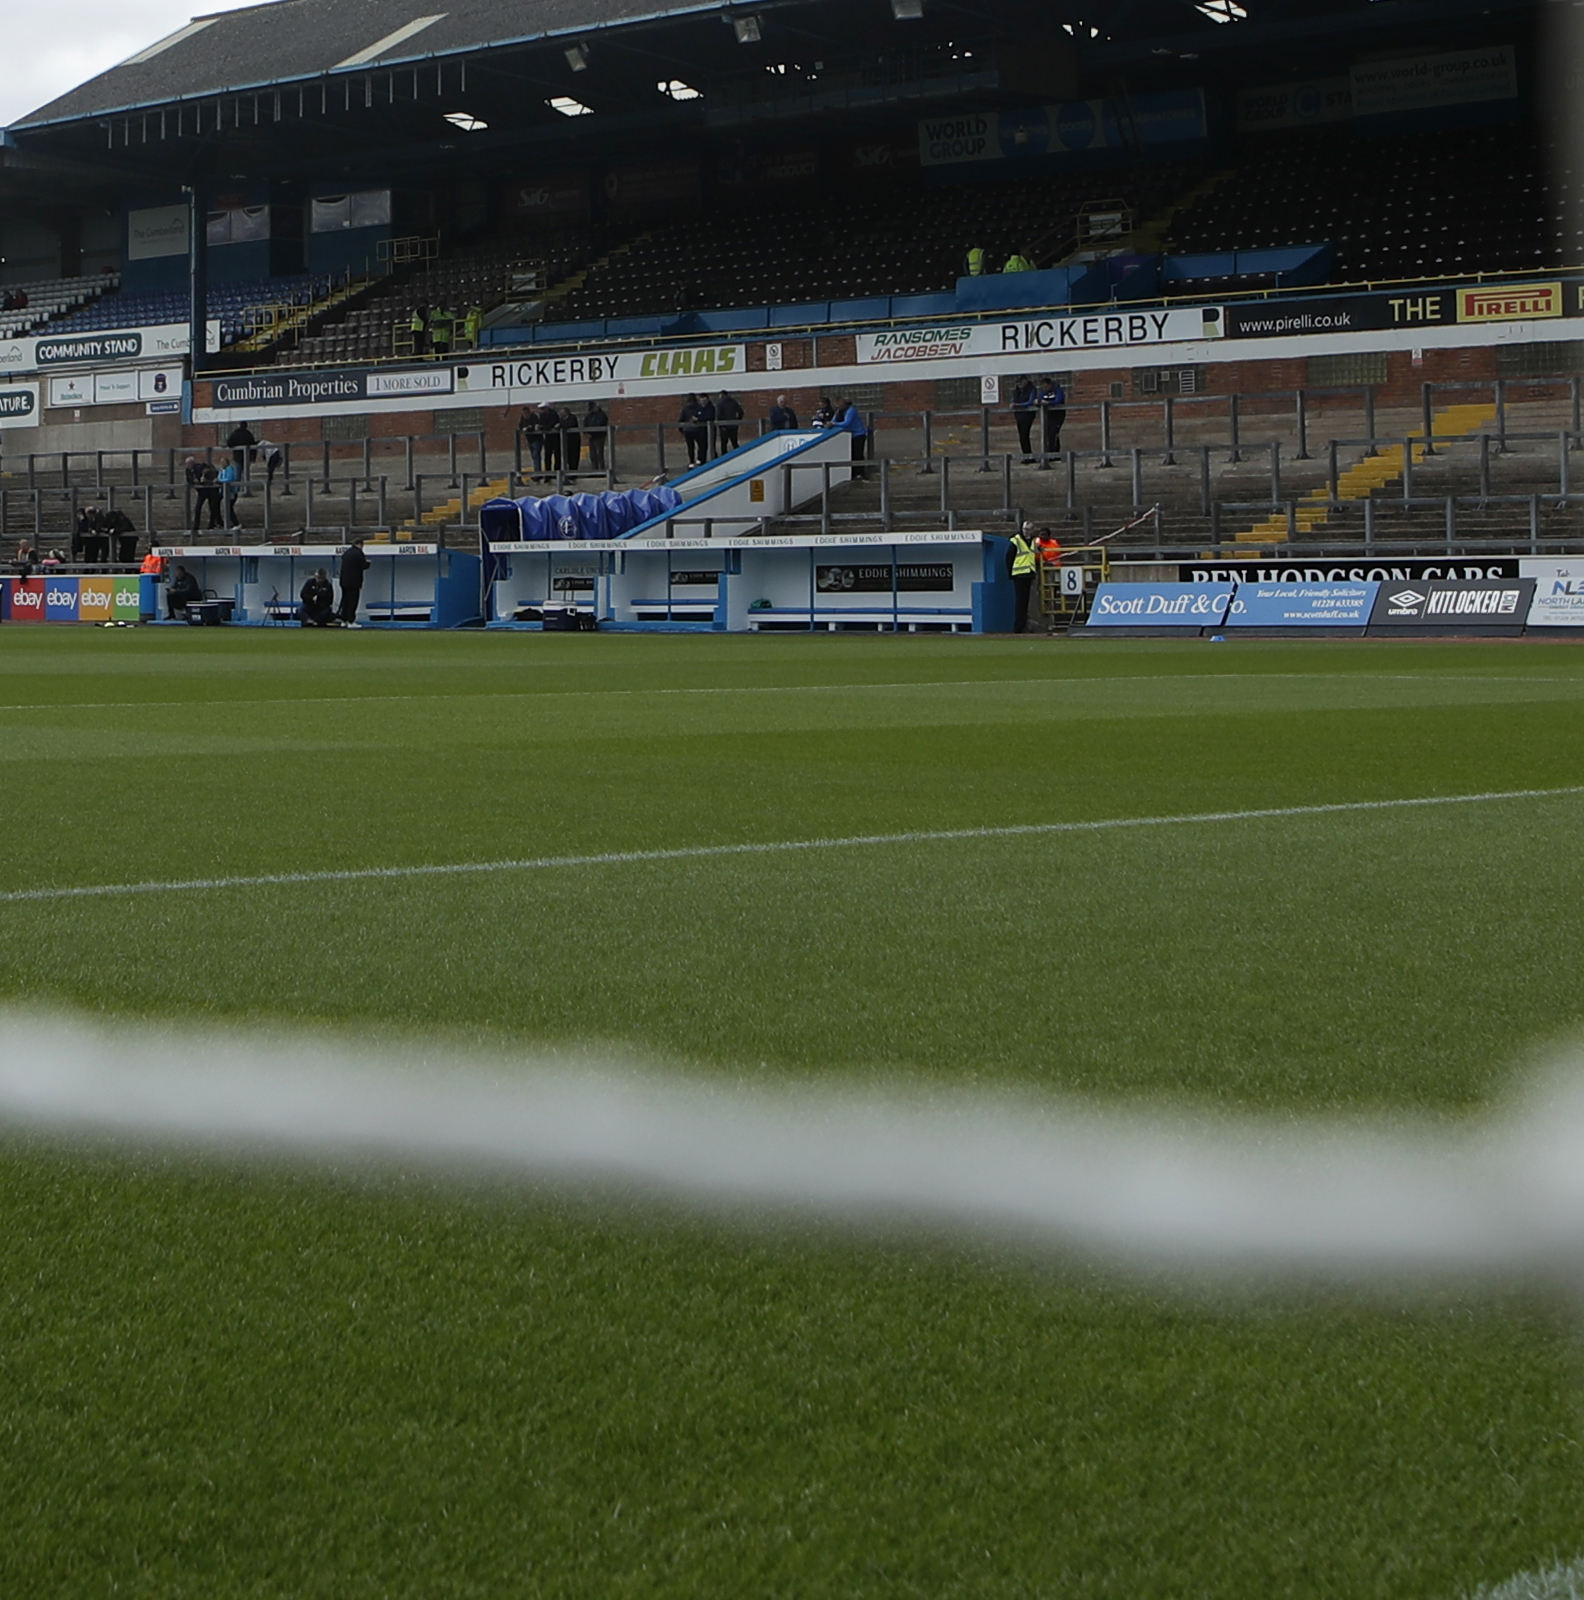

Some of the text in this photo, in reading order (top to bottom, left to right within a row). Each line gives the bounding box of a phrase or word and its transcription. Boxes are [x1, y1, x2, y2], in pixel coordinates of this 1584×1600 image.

[1355, 53, 1508, 84] www.world-group.co.uk
[1245, 93, 1287, 108] WORLD
[1245, 105, 1287, 121] GROUP
[926, 118, 988, 142] WORLD
[929, 137, 986, 159] GROUP
[1389, 295, 1442, 322] THE
[1464, 288, 1554, 317] PIRELLI
[1001, 312, 1170, 351] RICKERBY
[1239, 312, 1351, 333] www.pirelli.co.uk
[157, 339, 170, 350] The
[874, 327, 972, 348] RANSOMES
[39, 338, 137, 360] COMMUNITY STAND
[870, 342, 964, 362] JACOBSEN
[492, 355, 620, 387] RICKERBY
[640, 347, 737, 378] CLAAS
[217, 380, 283, 401] Cumbrian
[288, 377, 359, 402] Properties
[383, 376, 412, 390] MORE
[413, 374, 441, 389] SOLD
[858, 567, 953, 579] EDDIE SHIMMINGS
[1066, 572, 1078, 591] 8
[13, 586, 44, 611] ebay
[46, 586, 78, 610] ebay
[81, 586, 112, 610] ebay
[115, 586, 140, 606] eba
[1256, 588, 1367, 599] Your Local, Friendly Solicitors
[1427, 590, 1501, 614] KITLOCKER
[1097, 594, 1144, 616] Scott
[1145, 594, 1195, 615] Duff
[1387, 607, 1418, 615] umbro
